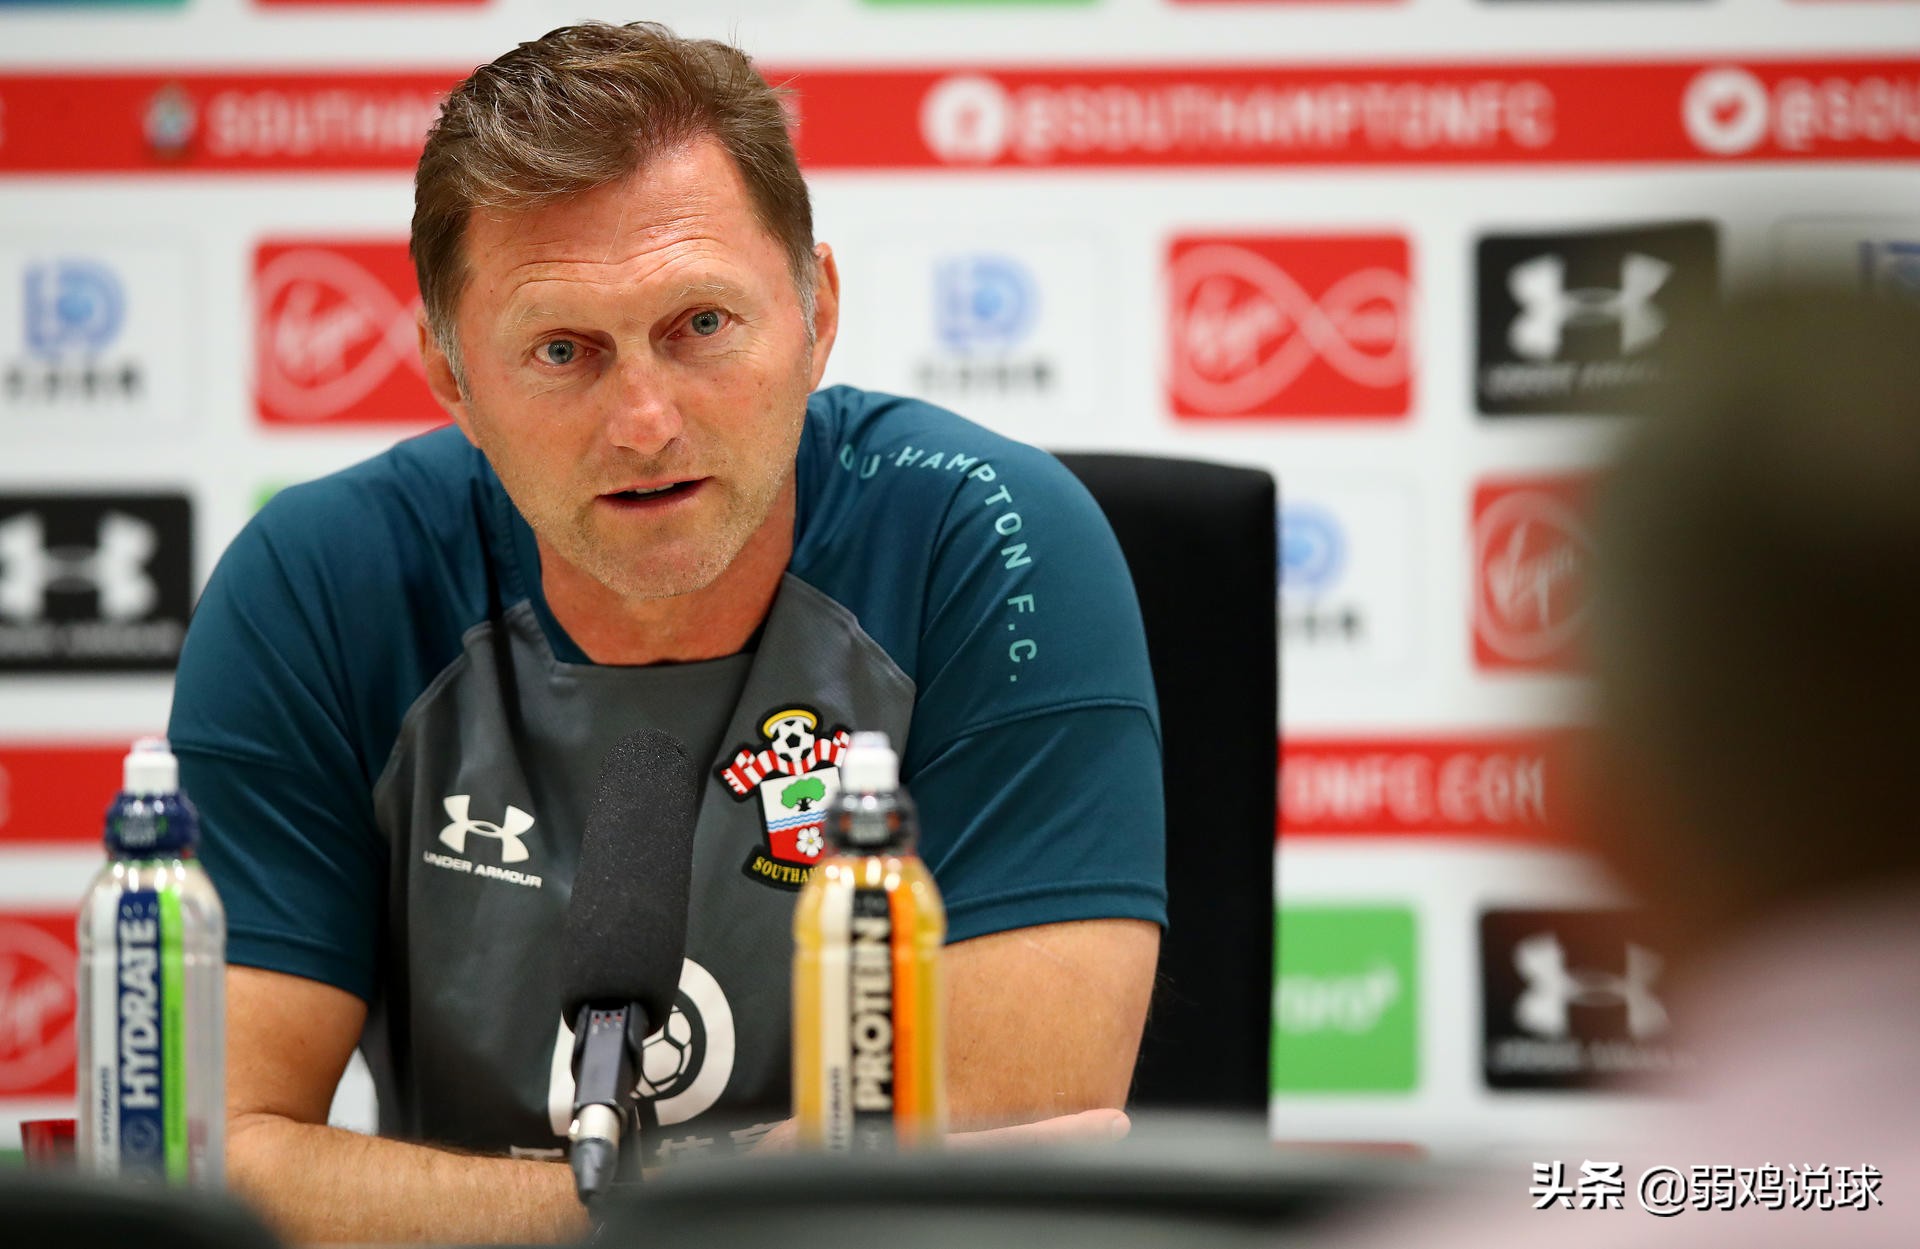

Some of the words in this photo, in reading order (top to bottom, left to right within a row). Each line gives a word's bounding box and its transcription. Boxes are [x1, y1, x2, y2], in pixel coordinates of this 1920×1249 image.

[839, 443, 1033, 570] OUHAMPTON
[1007, 593, 1037, 682] F.C.
[423, 850, 472, 873] UNDER
[474, 864, 542, 888] ARMOUR
[752, 855, 817, 884] SOUTHA
[121, 919, 160, 1109] HYDRATE
[853, 916, 894, 1111] PROTEIN
